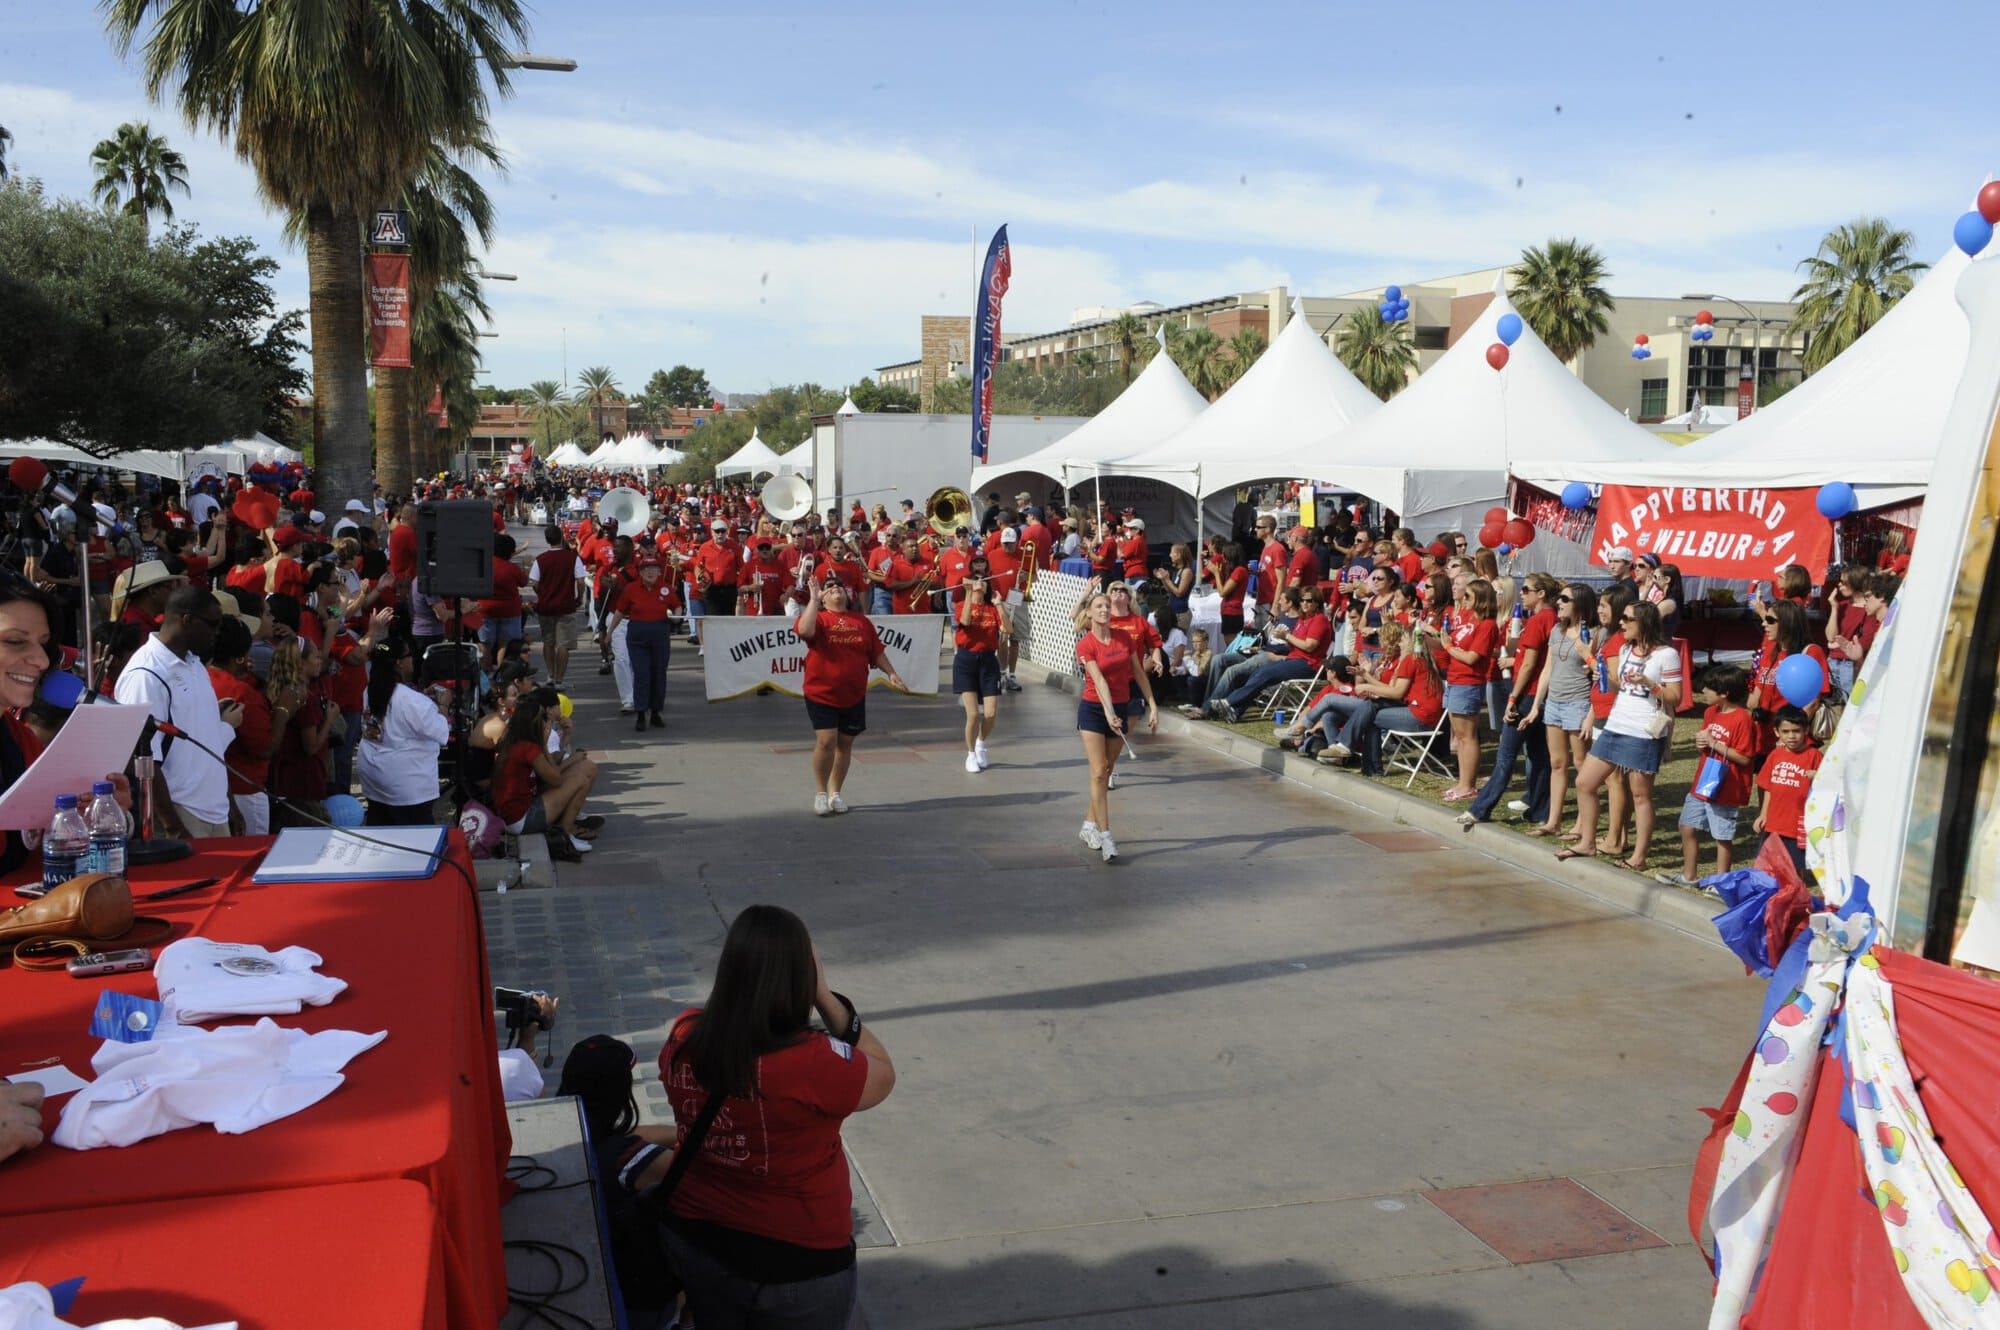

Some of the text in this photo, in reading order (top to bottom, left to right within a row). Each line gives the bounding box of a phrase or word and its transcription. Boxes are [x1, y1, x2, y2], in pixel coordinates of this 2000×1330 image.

[372, 213, 405, 243] A
[372, 286, 406, 295] Everything
[385, 295, 407, 303] Expect
[374, 319, 406, 327] University
[730, 625, 912, 662] UNIVERS ZONA
[771, 657, 807, 674] ALUM
